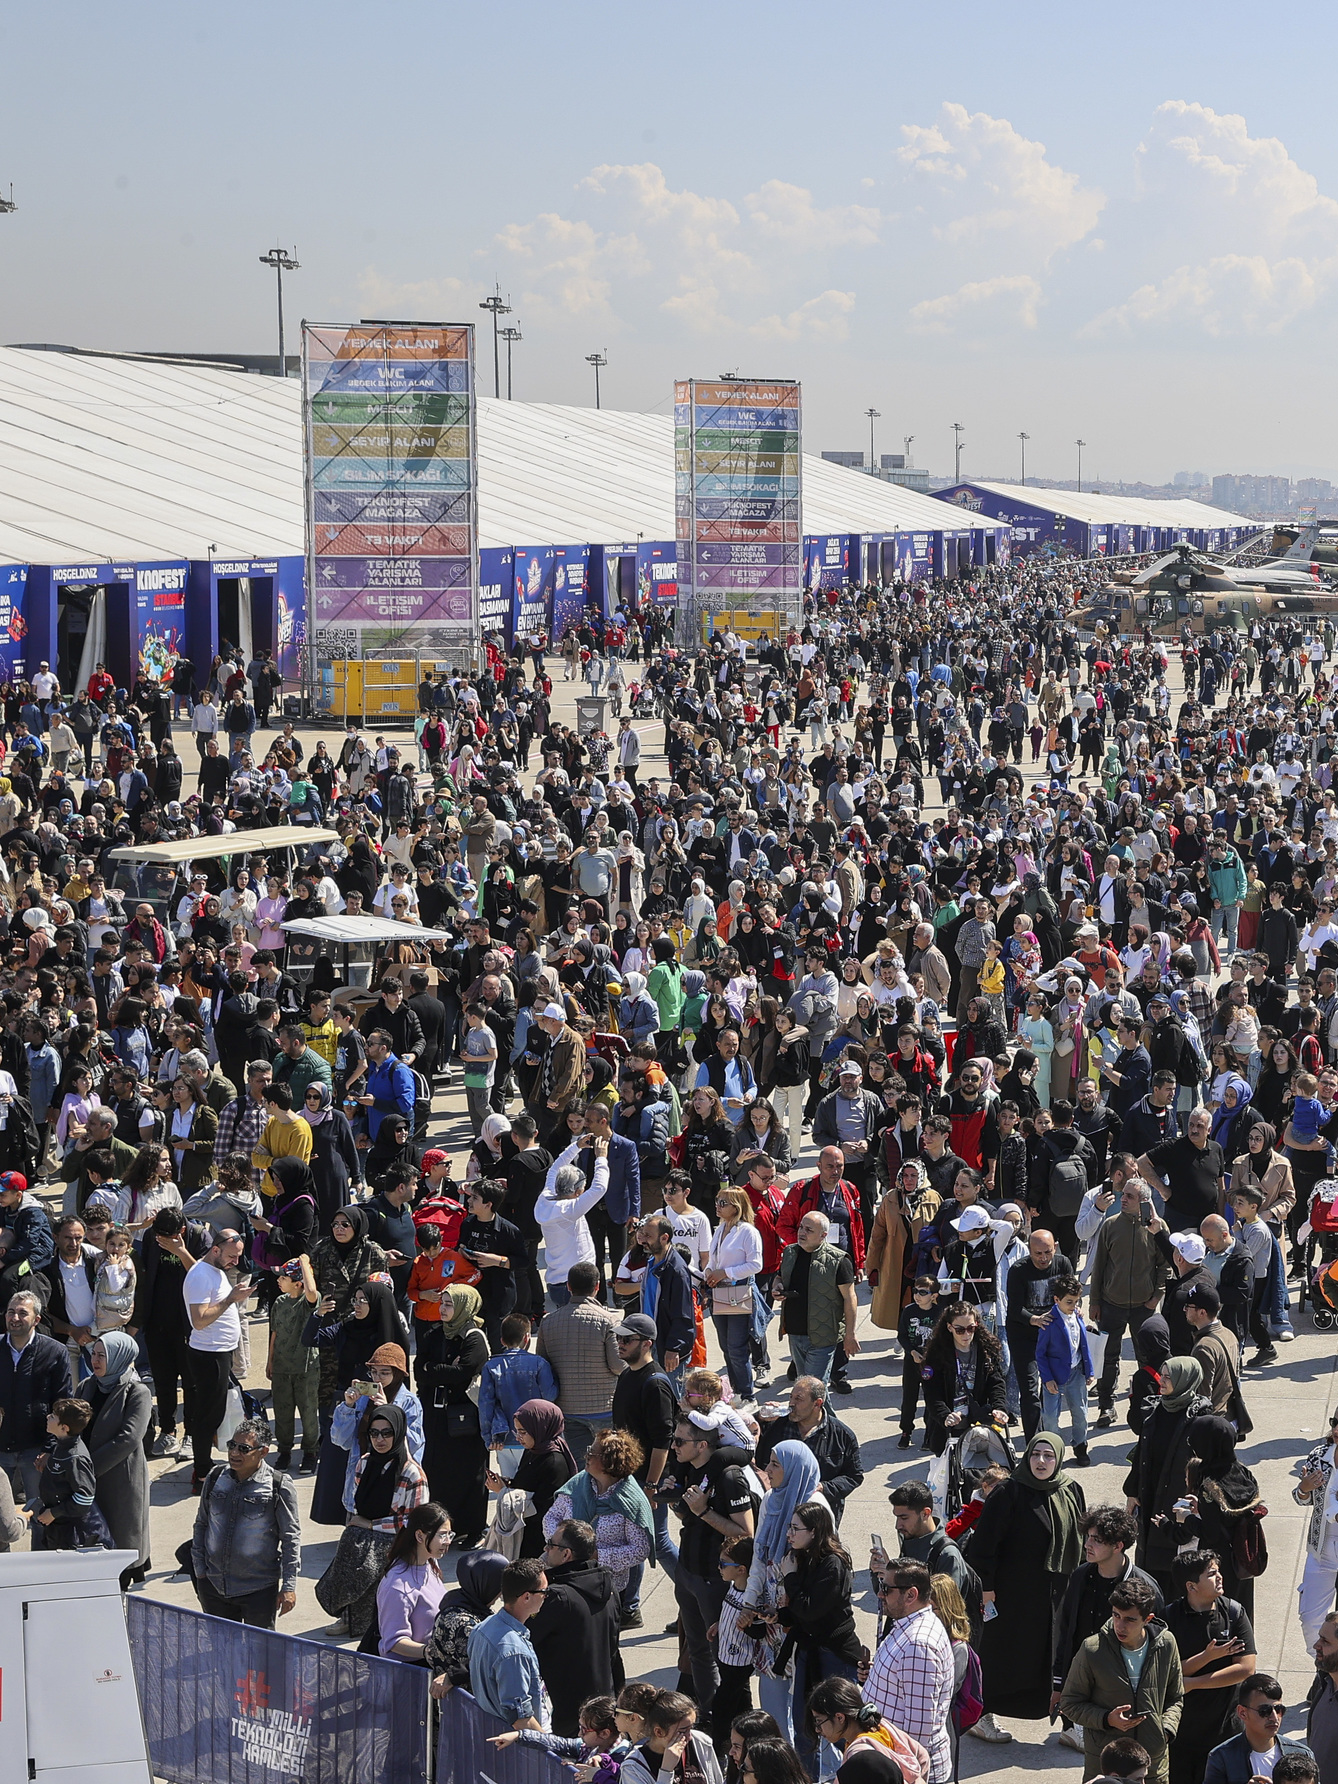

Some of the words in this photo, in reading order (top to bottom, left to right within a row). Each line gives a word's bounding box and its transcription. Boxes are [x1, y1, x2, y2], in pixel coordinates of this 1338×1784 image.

[341, 338, 392, 349] YEMEK
[395, 338, 438, 349] ALANI
[377, 367, 404, 378] WC
[715, 391, 748, 399] YEMEK
[750, 392, 778, 400] ALANI
[738, 412, 756, 420] WC
[394, 438, 435, 447] ALANI
[356, 498, 431, 507] TEKNOFEST
[368, 578, 422, 586] ALANLARI
[378, 605, 412, 616] OFİSİ
[270, 1709, 312, 1738] MİLLİ
[231, 1717, 309, 1757] TEKNOLOJİ
[242, 1741, 304, 1777] HAMLESİ
